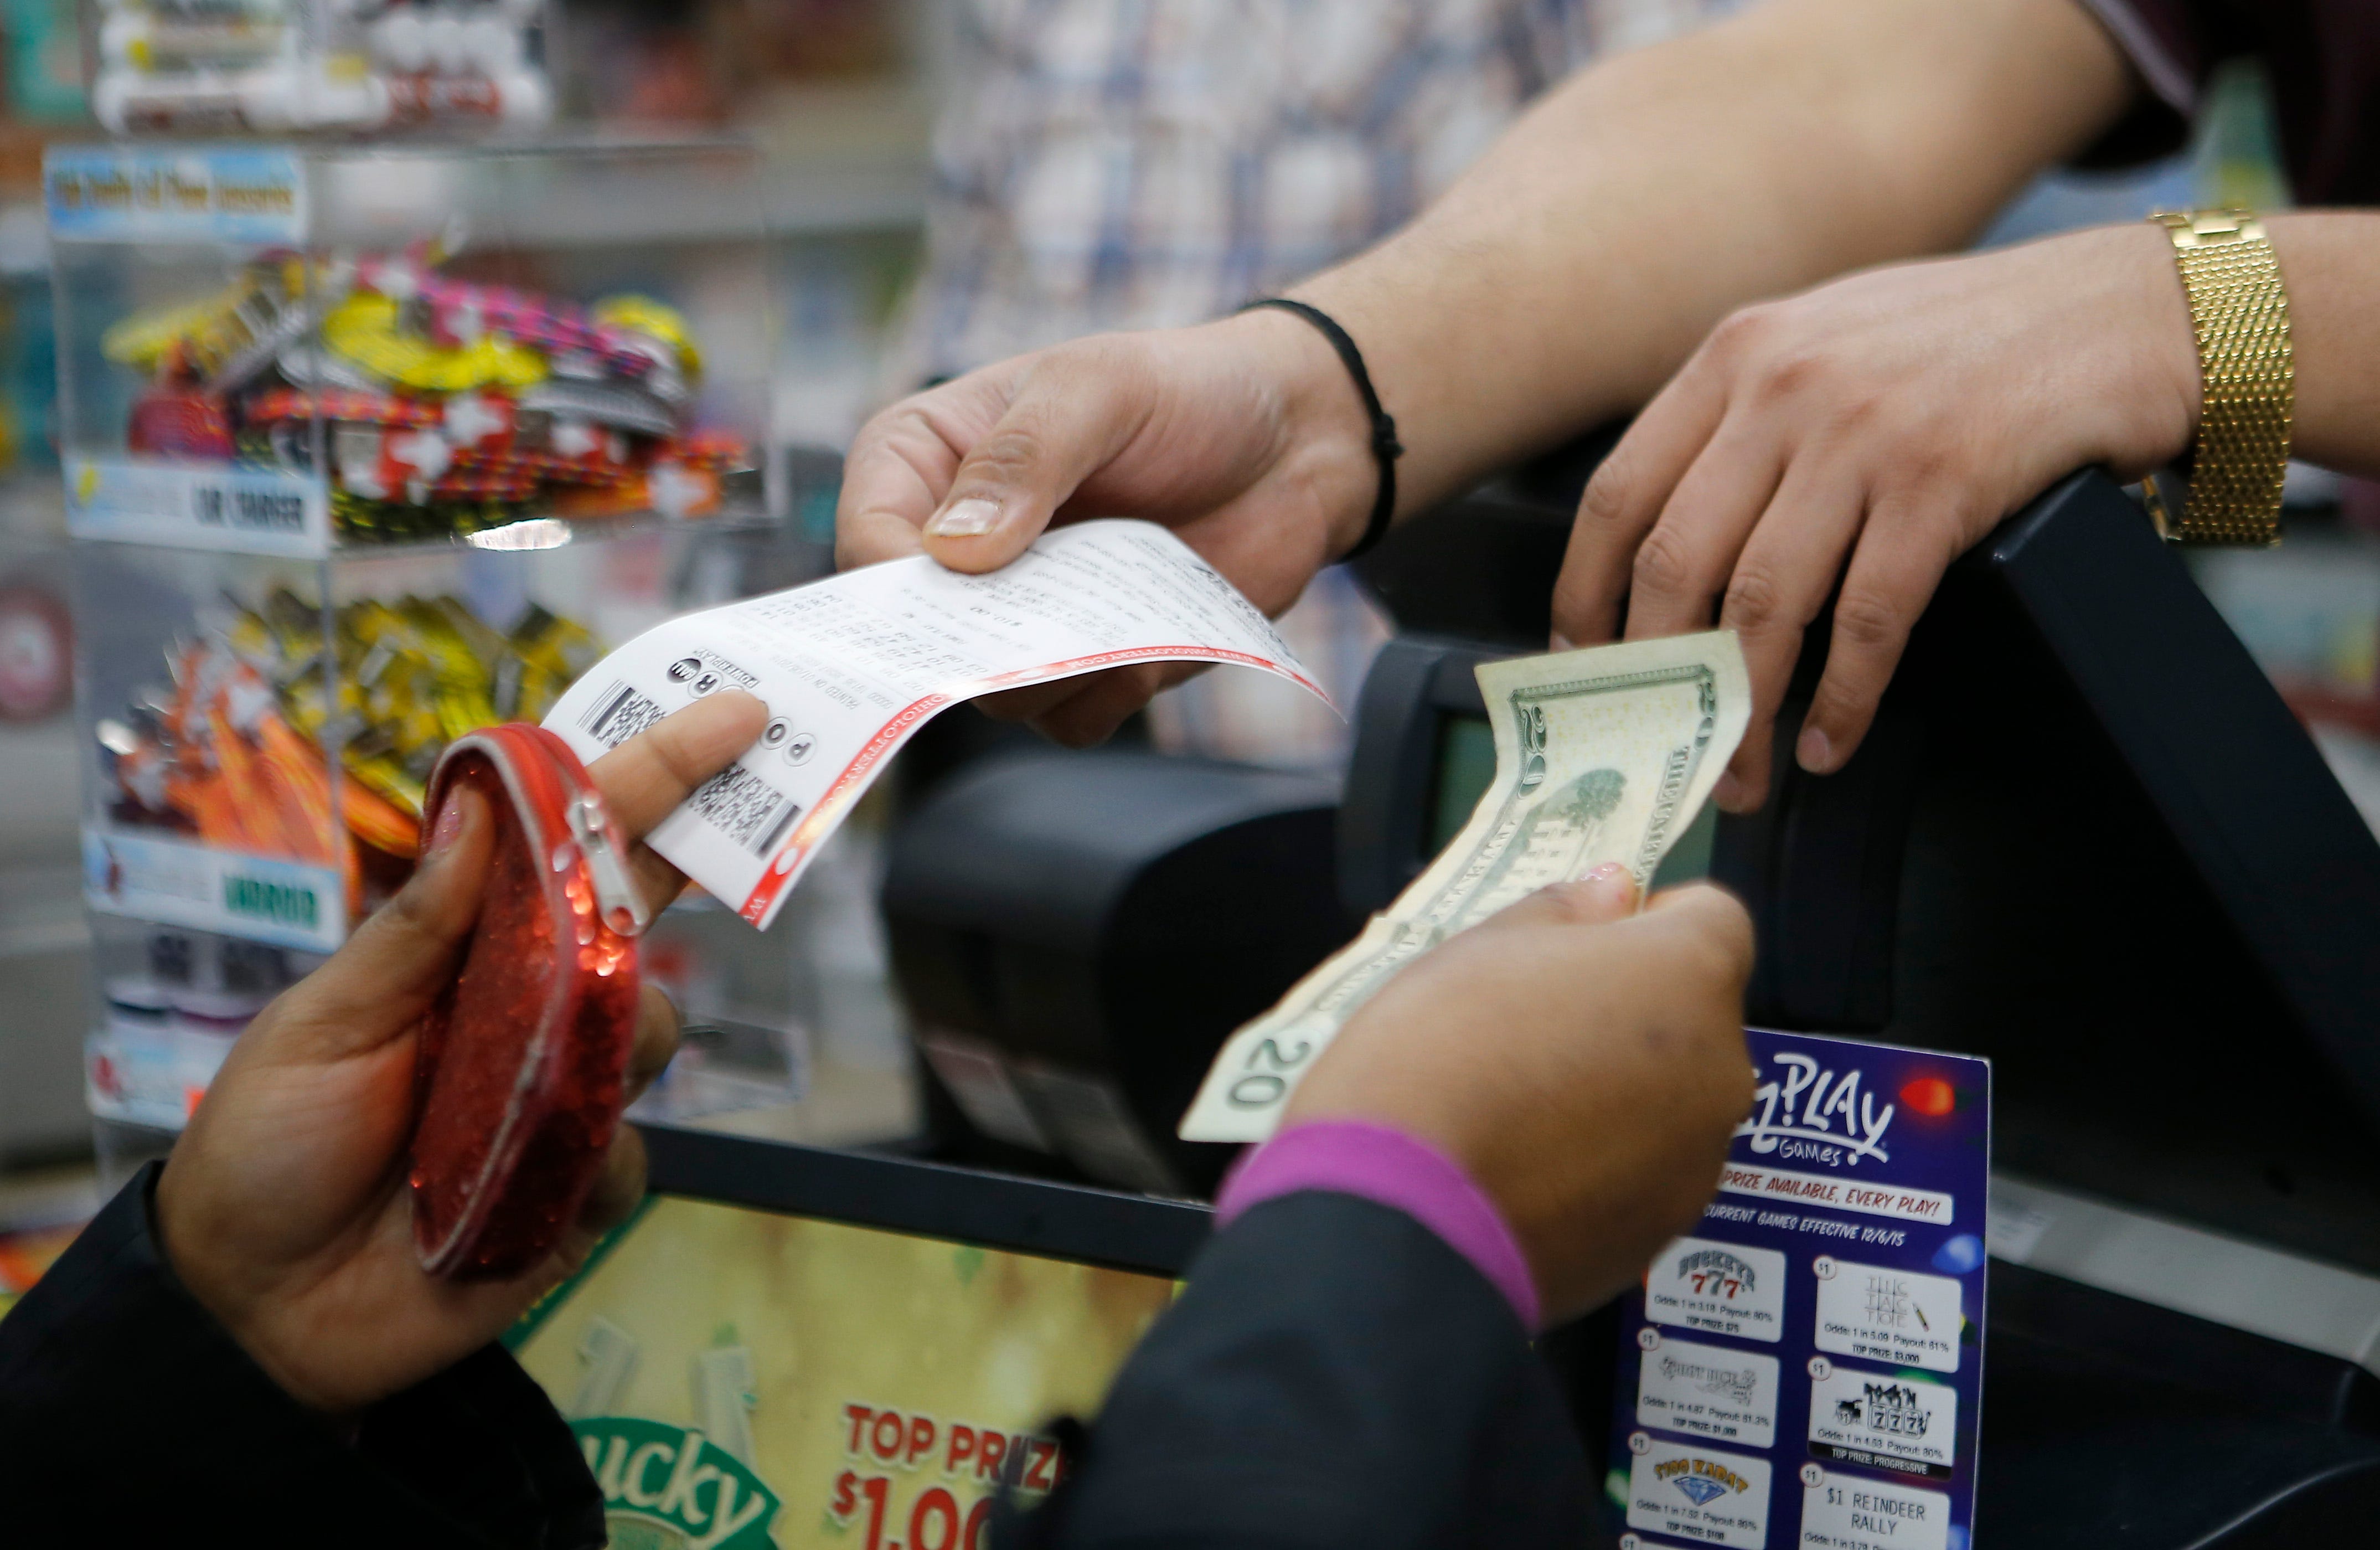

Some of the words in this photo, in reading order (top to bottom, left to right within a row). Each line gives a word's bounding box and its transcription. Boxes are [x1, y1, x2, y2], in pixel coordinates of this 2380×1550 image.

[1226, 1038, 1312, 1111] 20
[1723, 1171, 1763, 1190] PRIZE
[1846, 1188, 1895, 1210] EVERY
[1896, 1196, 1940, 1217] PLAY!
[1703, 1204, 1757, 1223] CURRENT
[1758, 1210, 1799, 1230] GAMES
[1799, 1219, 1860, 1240] EFFECTIVE
[1861, 1226, 1907, 1247] 12/6/15
[1852, 1344, 1866, 1354] TOP
[1893, 1335, 1927, 1350] Payout:
[845, 1403, 936, 1465] TOP
[1672, 1417, 1686, 1427] TOP
[1832, 1448, 1847, 1460] TOP
[1873, 1455, 1929, 1475] PROGRESSIVE
[1887, 1441, 1920, 1455] Payout:
[580, 1428, 768, 1550] ucky
[1827, 1487, 1843, 1506] $1
[1852, 1493, 1925, 1522] REINDEER
[1665, 1521, 1680, 1532] TOP
[1851, 1513, 1898, 1537] RALLY
